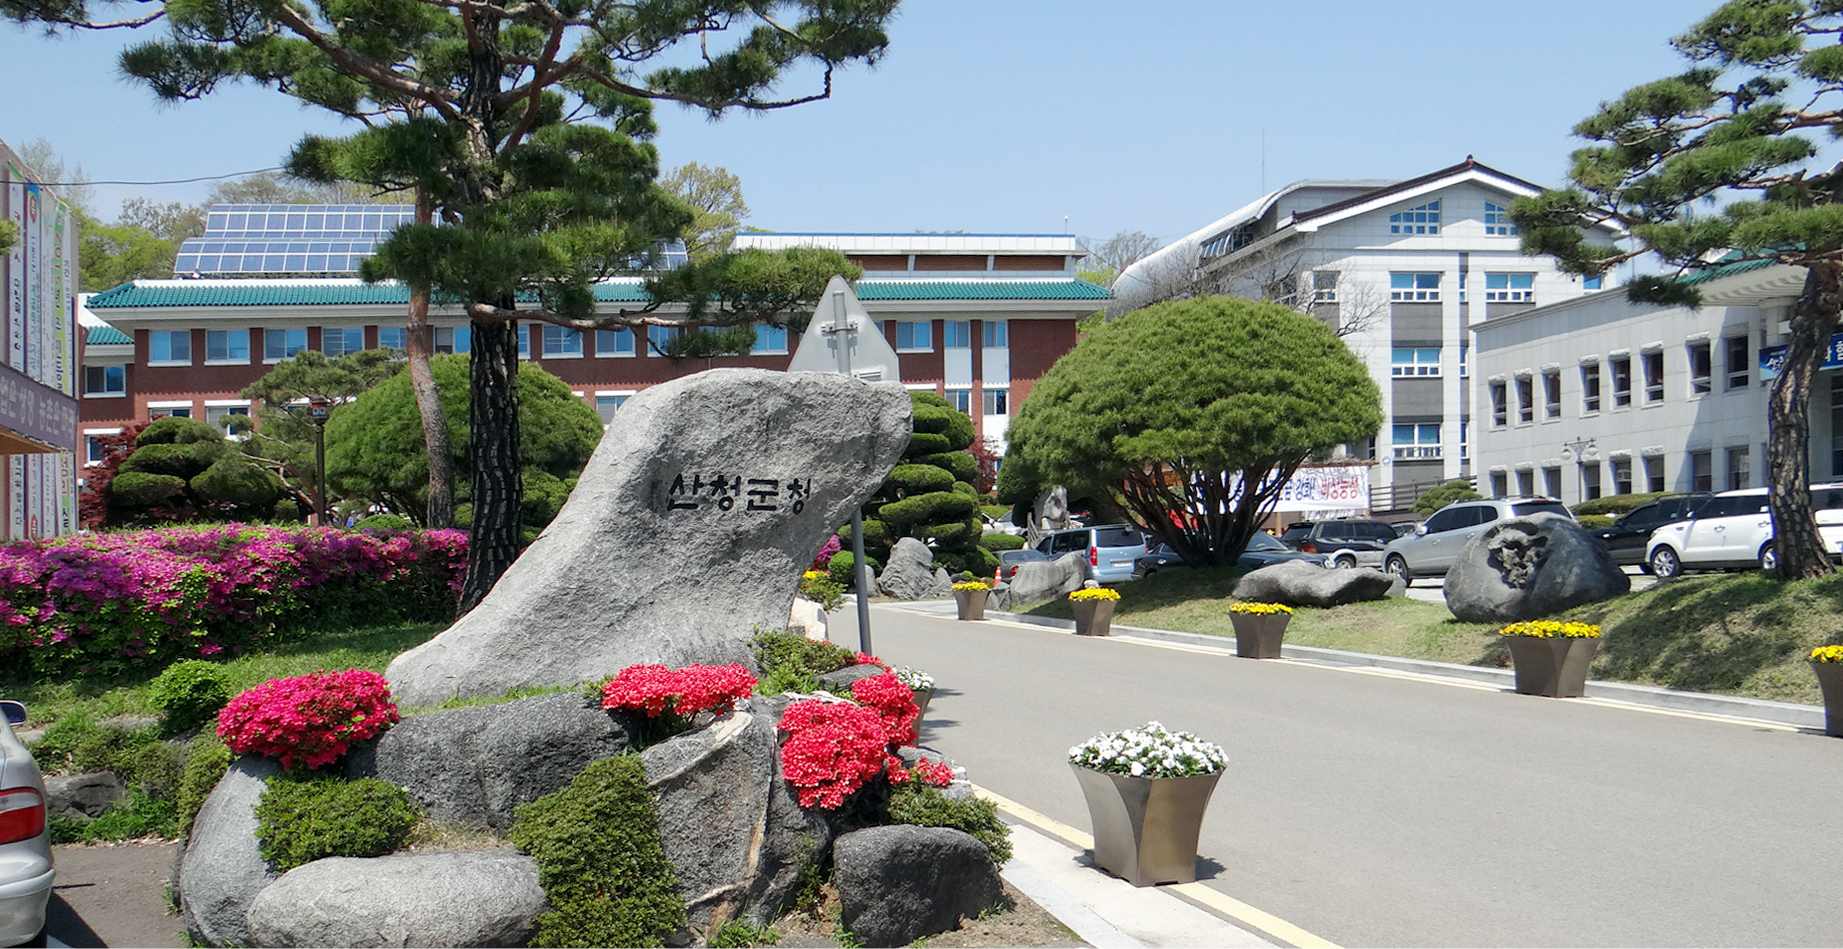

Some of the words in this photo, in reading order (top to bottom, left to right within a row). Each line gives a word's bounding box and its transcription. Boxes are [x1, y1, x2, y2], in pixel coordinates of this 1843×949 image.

[19, 386, 36, 428] 생명
[38, 394, 61, 436] 농촌은
[667, 473, 813, 515] 산청군청
